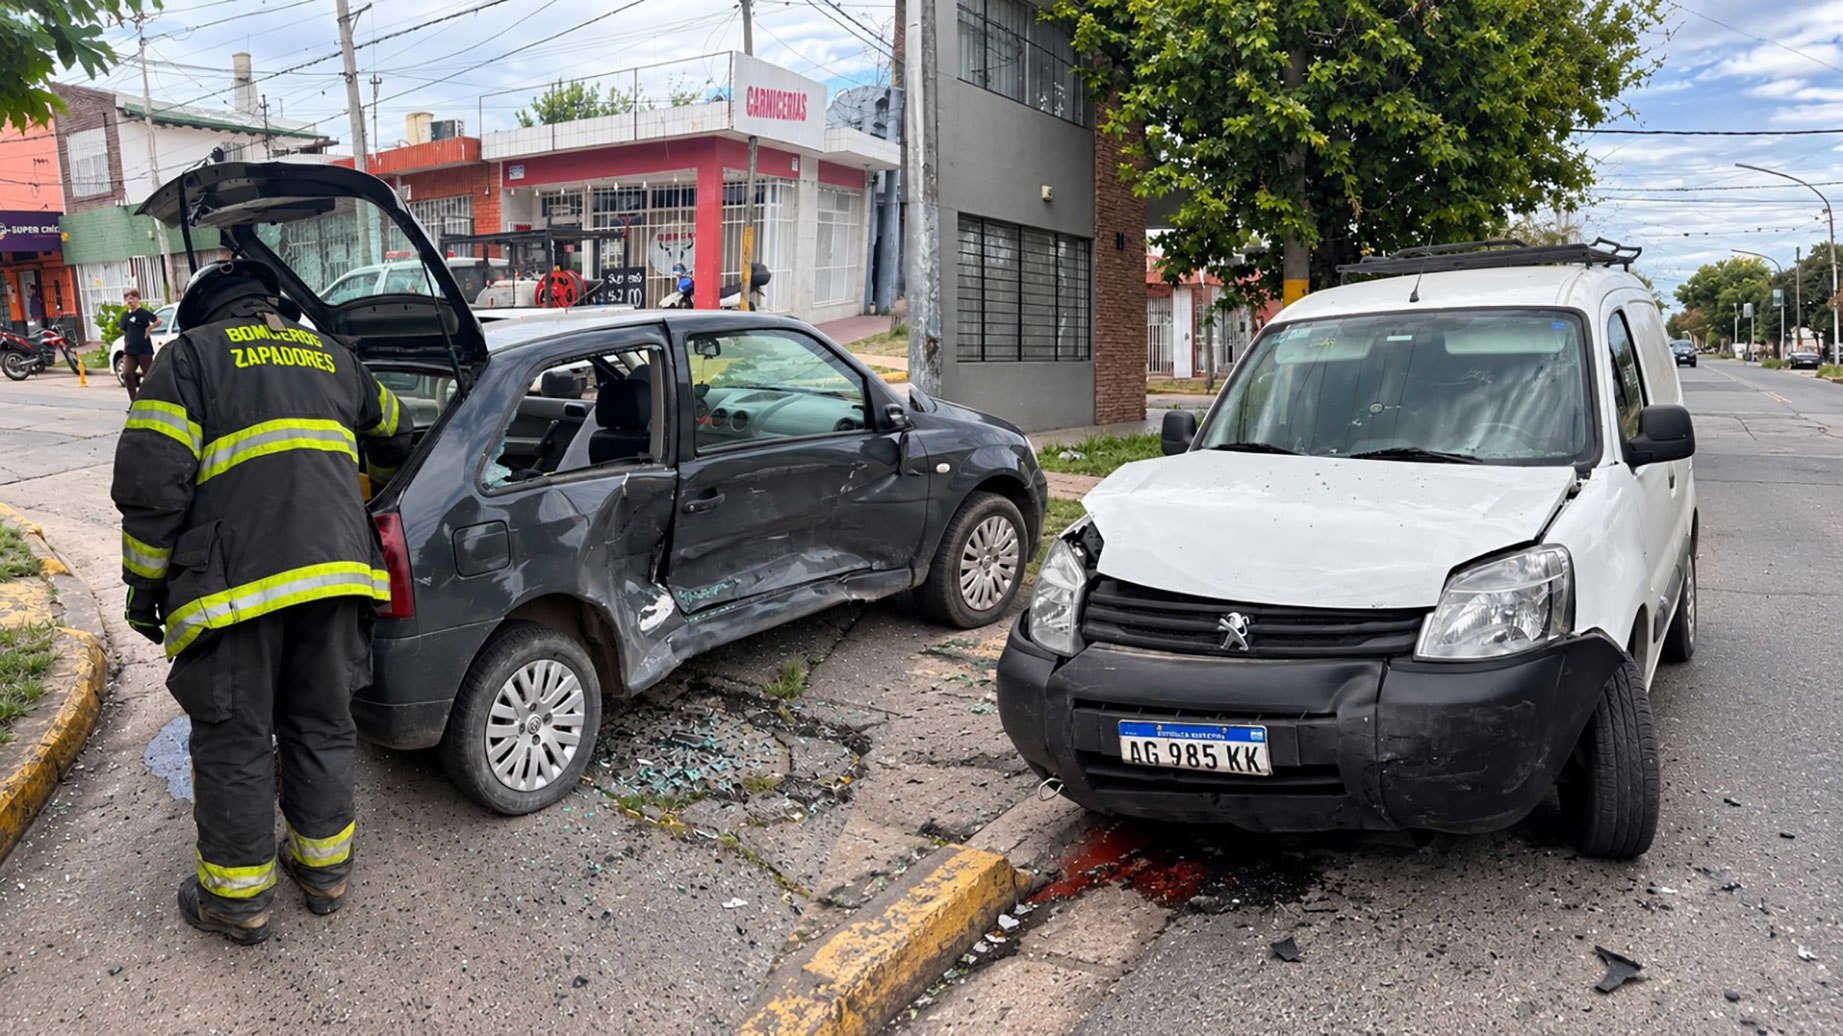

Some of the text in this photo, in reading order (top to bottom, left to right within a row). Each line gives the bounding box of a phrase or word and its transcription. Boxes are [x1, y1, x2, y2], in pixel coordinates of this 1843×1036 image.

[230, 345, 336, 373] ZAPADORES
[1130, 741, 1262, 772] AG 985 KK
